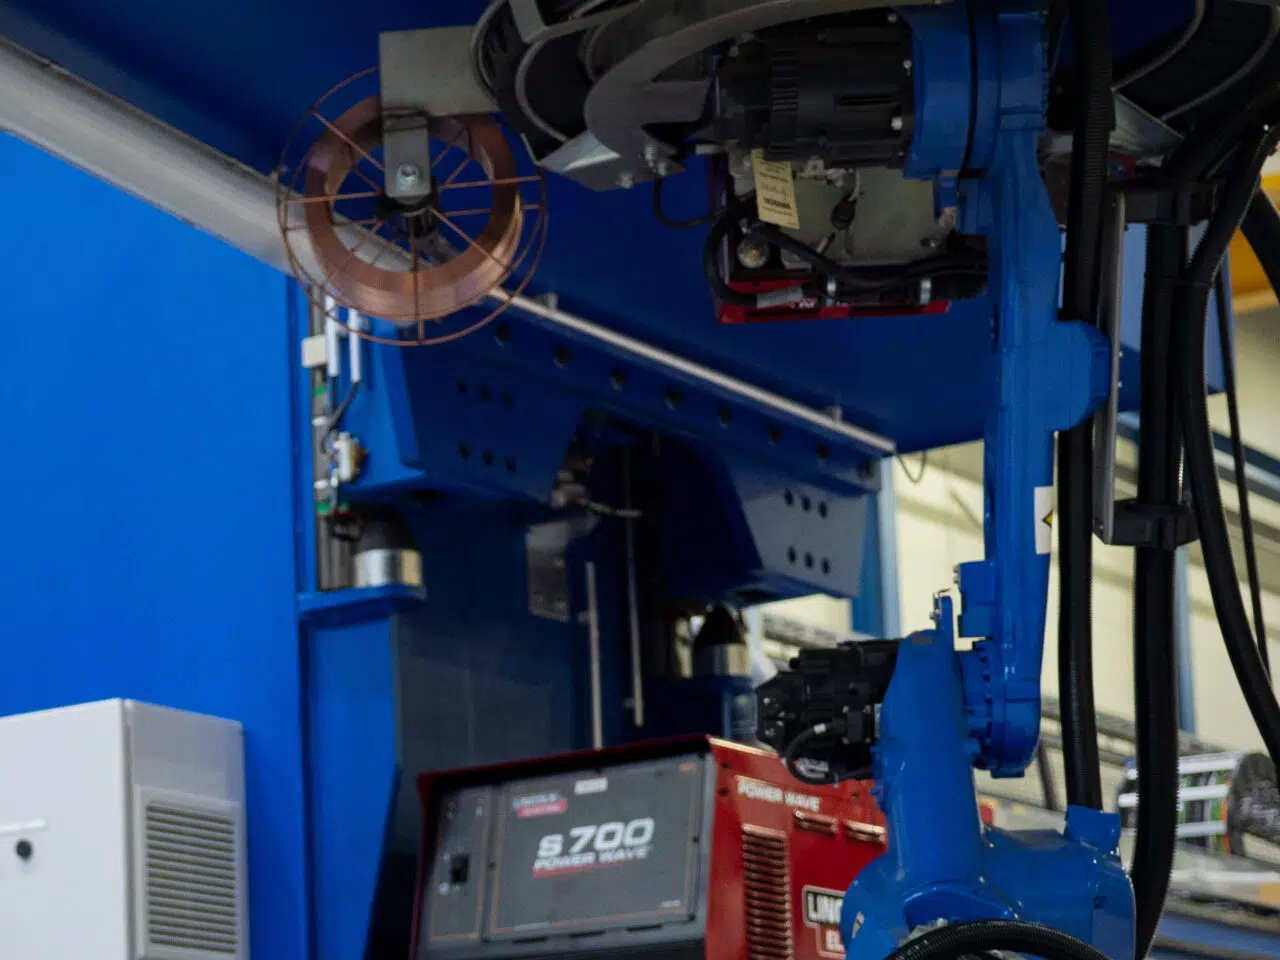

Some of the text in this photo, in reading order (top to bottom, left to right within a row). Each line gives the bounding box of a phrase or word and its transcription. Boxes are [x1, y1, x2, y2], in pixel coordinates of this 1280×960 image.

[570, 817, 654, 853] 700
[533, 845, 648, 871] POWER WAVE
